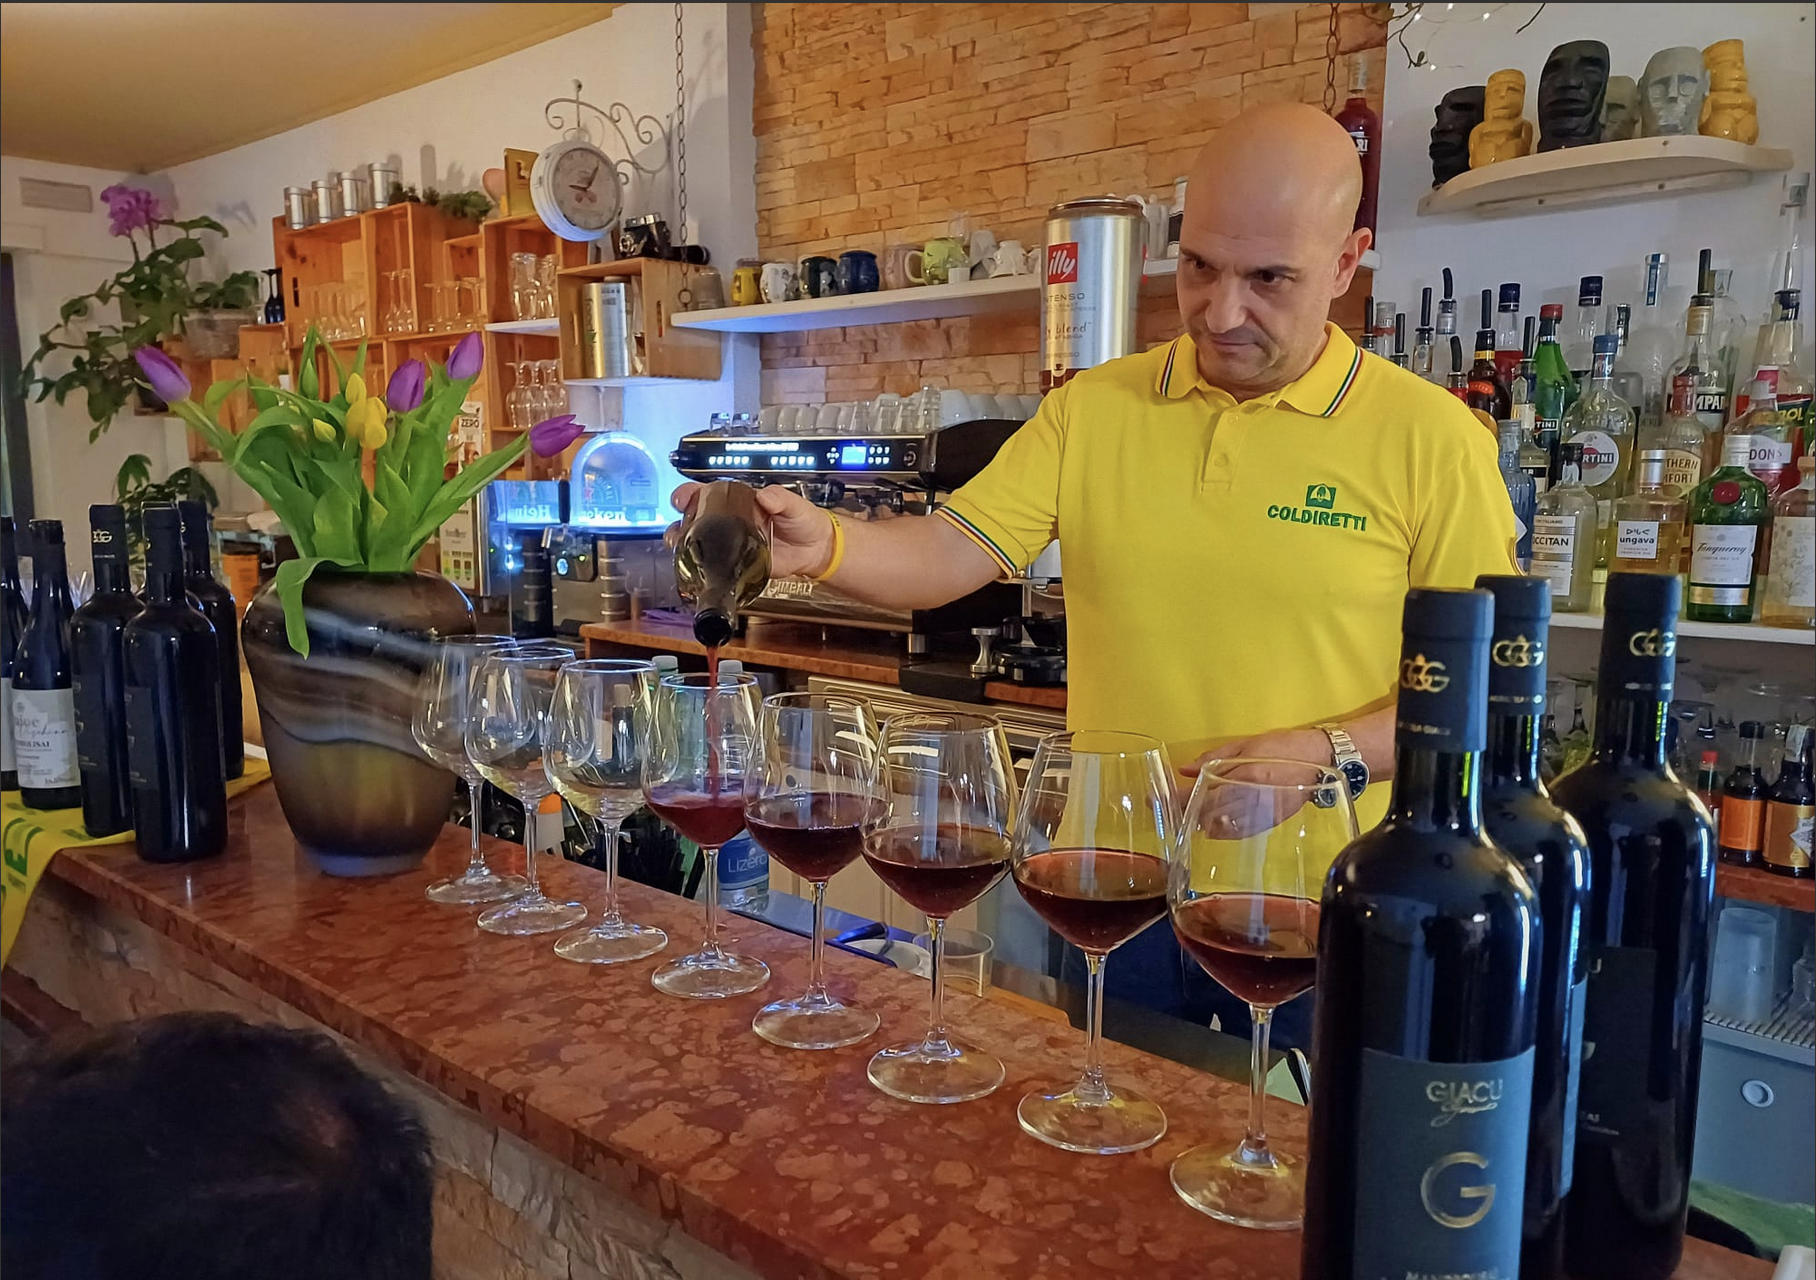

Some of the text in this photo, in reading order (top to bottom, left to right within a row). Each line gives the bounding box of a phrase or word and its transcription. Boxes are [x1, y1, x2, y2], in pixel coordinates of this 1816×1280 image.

[1048, 249, 1076, 281] illy
[461, 418, 480, 429] ZERO
[1666, 458, 1698, 470] THERN
[1267, 504, 1368, 532] COLDIRETTI
[1619, 537, 1655, 546] ungava
[1697, 542, 1748, 555] Tanqueray
[1426, 1077, 1504, 1110] GIACU
[1420, 1151, 1496, 1229] G
